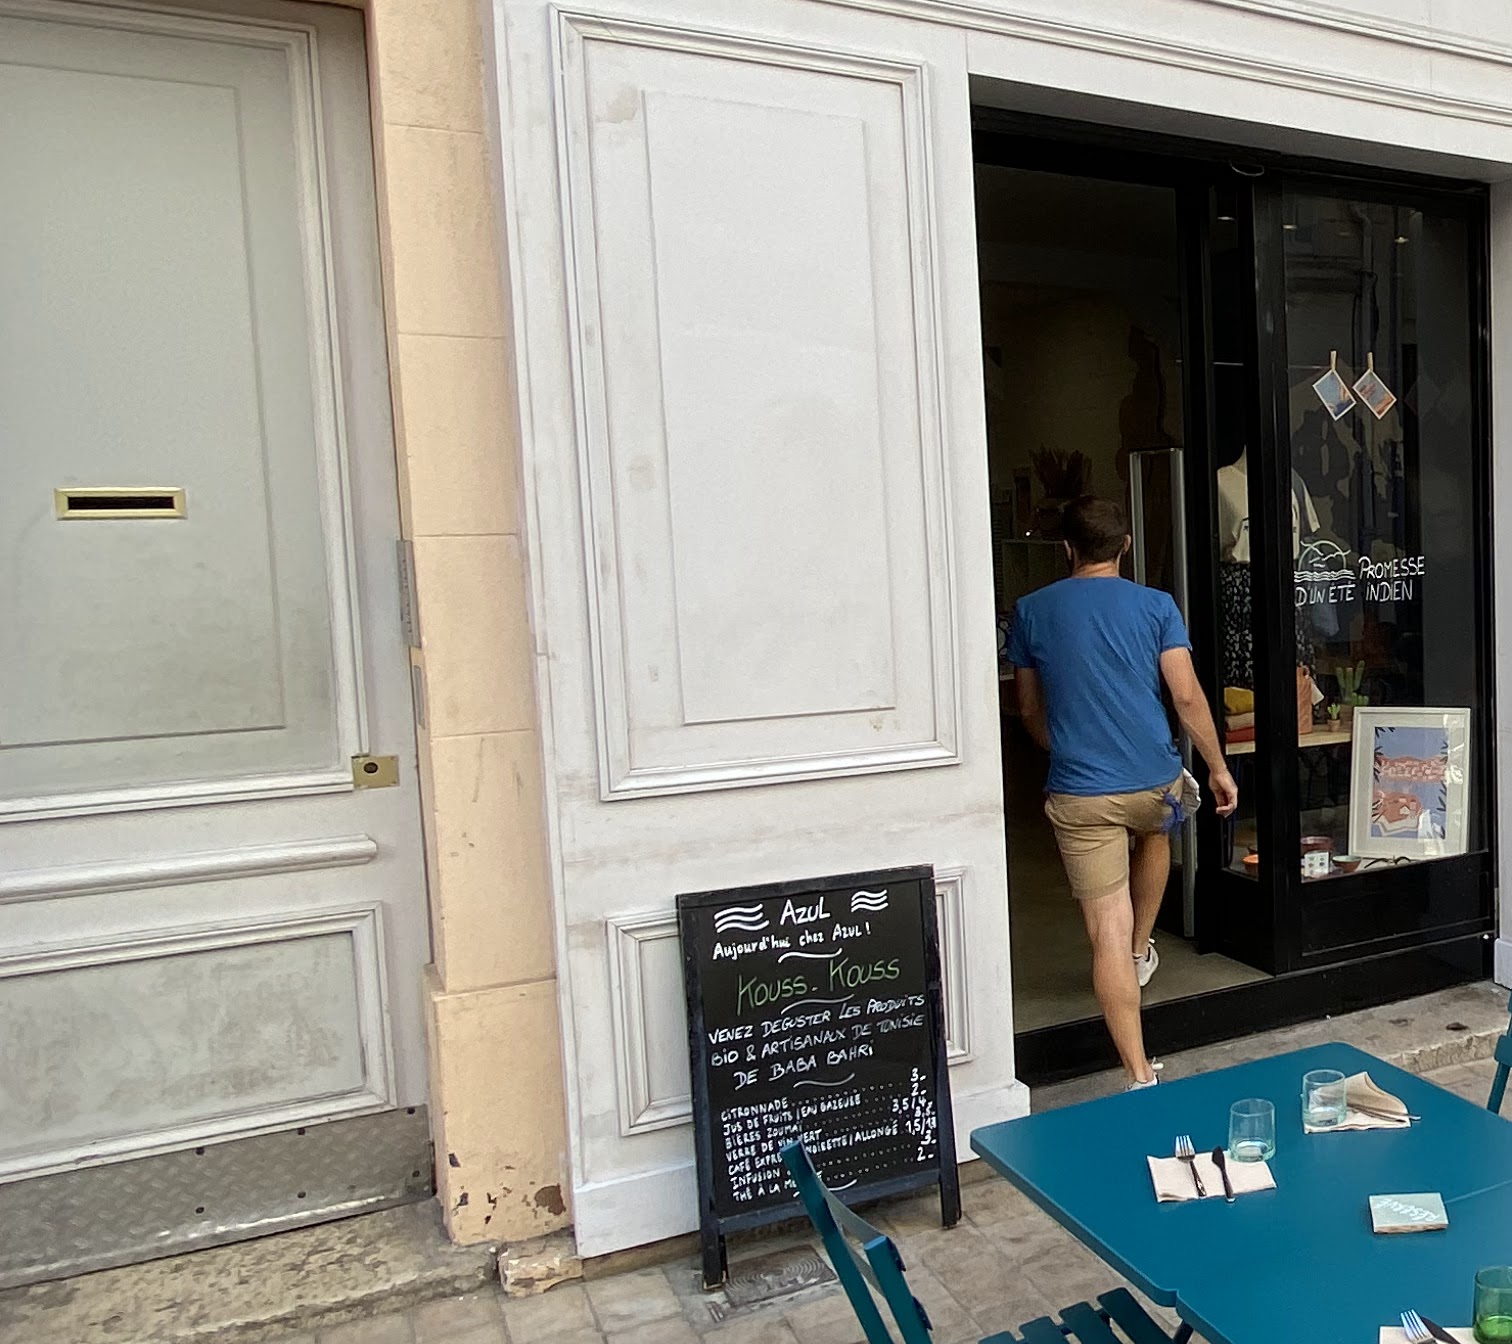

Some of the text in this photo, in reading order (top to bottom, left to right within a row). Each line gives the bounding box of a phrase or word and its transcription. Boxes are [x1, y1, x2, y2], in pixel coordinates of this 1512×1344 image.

[1358, 556, 1425, 579] PROMESSE
[1294, 585, 1326, 608] D'UN
[780, 896, 831, 925] AZUL
[712, 935, 791, 960] Aujourd'hui
[799, 930, 825, 947] chez
[708, 993, 926, 1045] VENEZ DEGUSTER LES PRODUITS
[710, 1048, 740, 1067] BIO
[745, 1044, 757, 1062] &
[761, 1027, 847, 1059] ARTISANAUX
[851, 1023, 873, 1040] DE
[733, 1040, 875, 1091] DE BABA BAHRI
[721, 1096, 788, 1122] CITRONNADE
[722, 1121, 743, 1136] JUS
[746, 1116, 760, 1130] DE
[763, 1110, 793, 1125] FRUITS
[725, 1144, 757, 1162] VERRE
[760, 1139, 774, 1153] DE
[730, 1167, 780, 1190] INFUSION
[768, 1183, 781, 1194] LA
